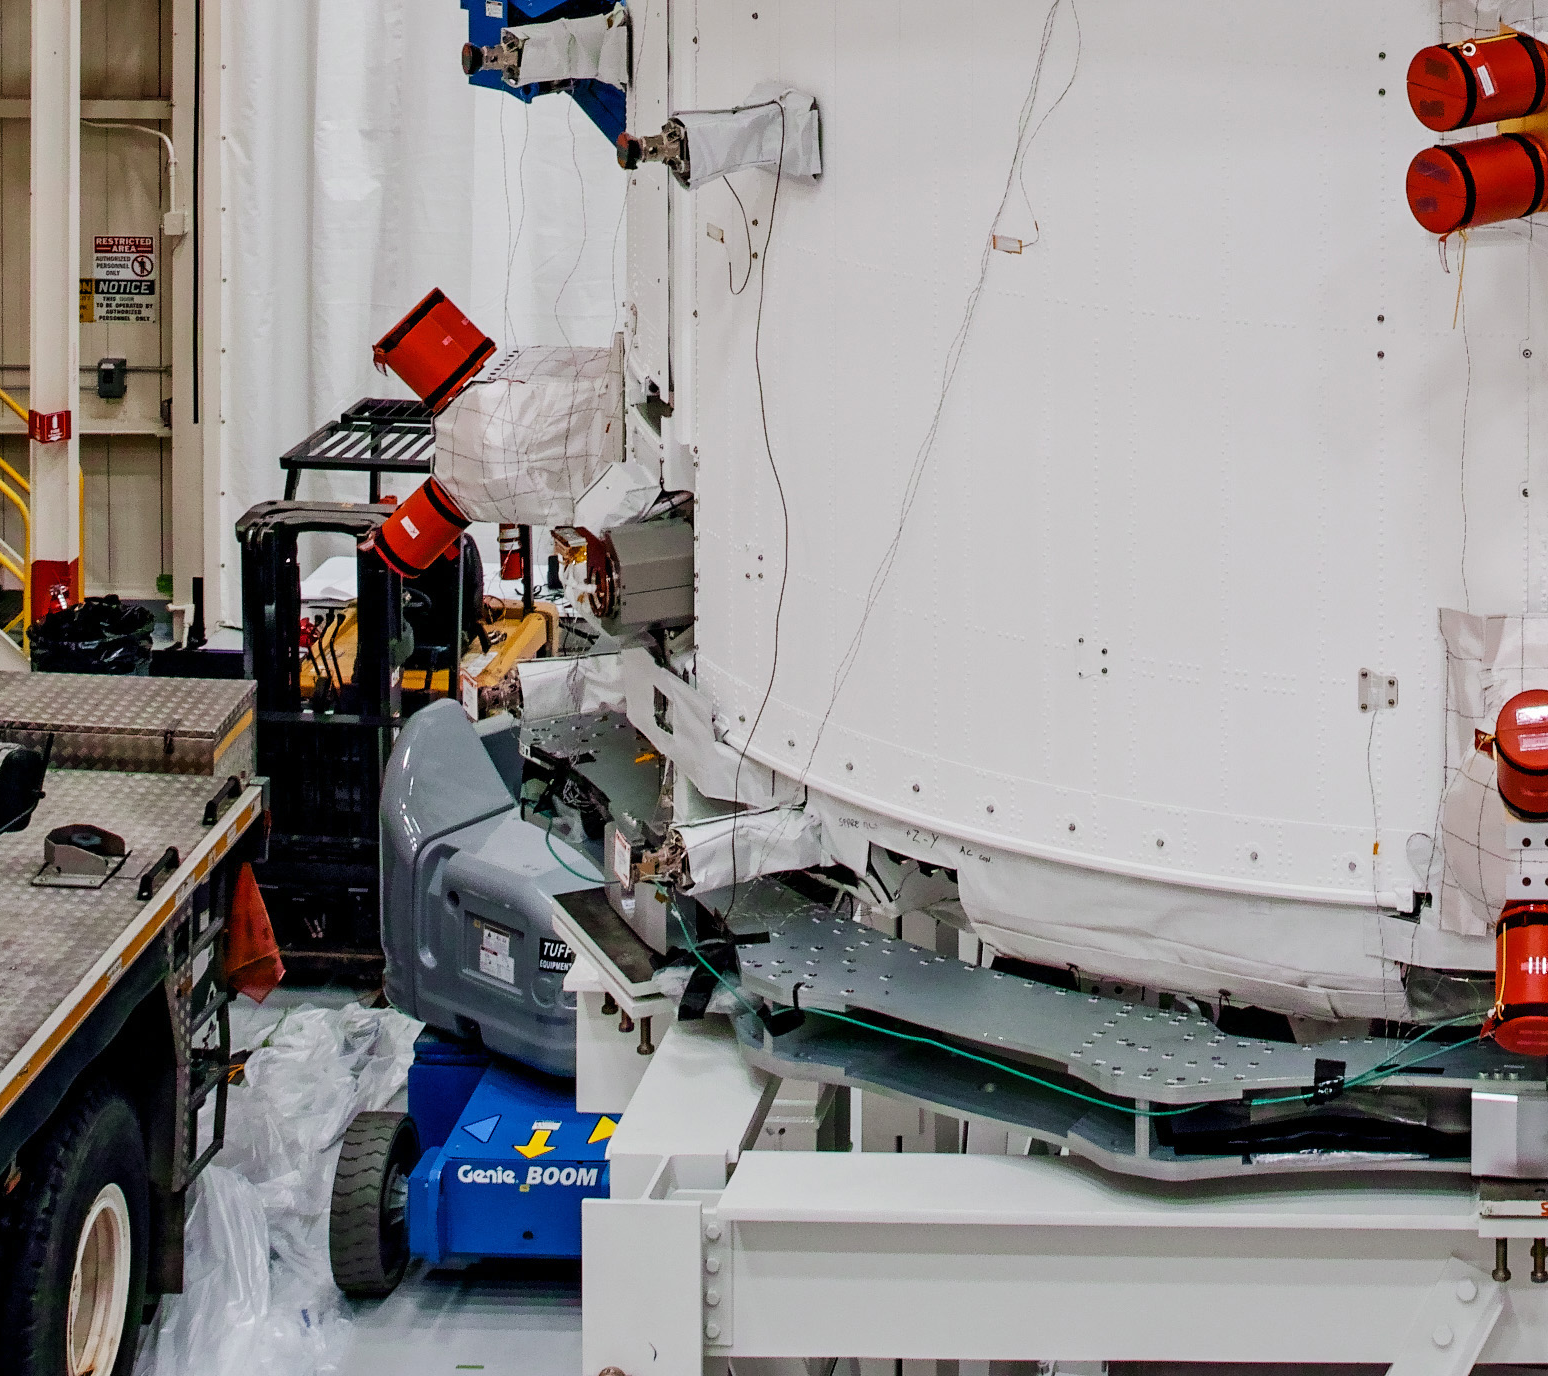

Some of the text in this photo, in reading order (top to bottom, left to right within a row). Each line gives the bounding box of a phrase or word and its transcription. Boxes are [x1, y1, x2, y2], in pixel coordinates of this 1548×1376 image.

[95, 237, 152, 246] RESTRICTED
[112, 245, 137, 253] AREA
[98, 281, 151, 293] NOTICE
[542, 941, 572, 958] TUFF
[457, 1164, 599, 1187] Genie BOOM
